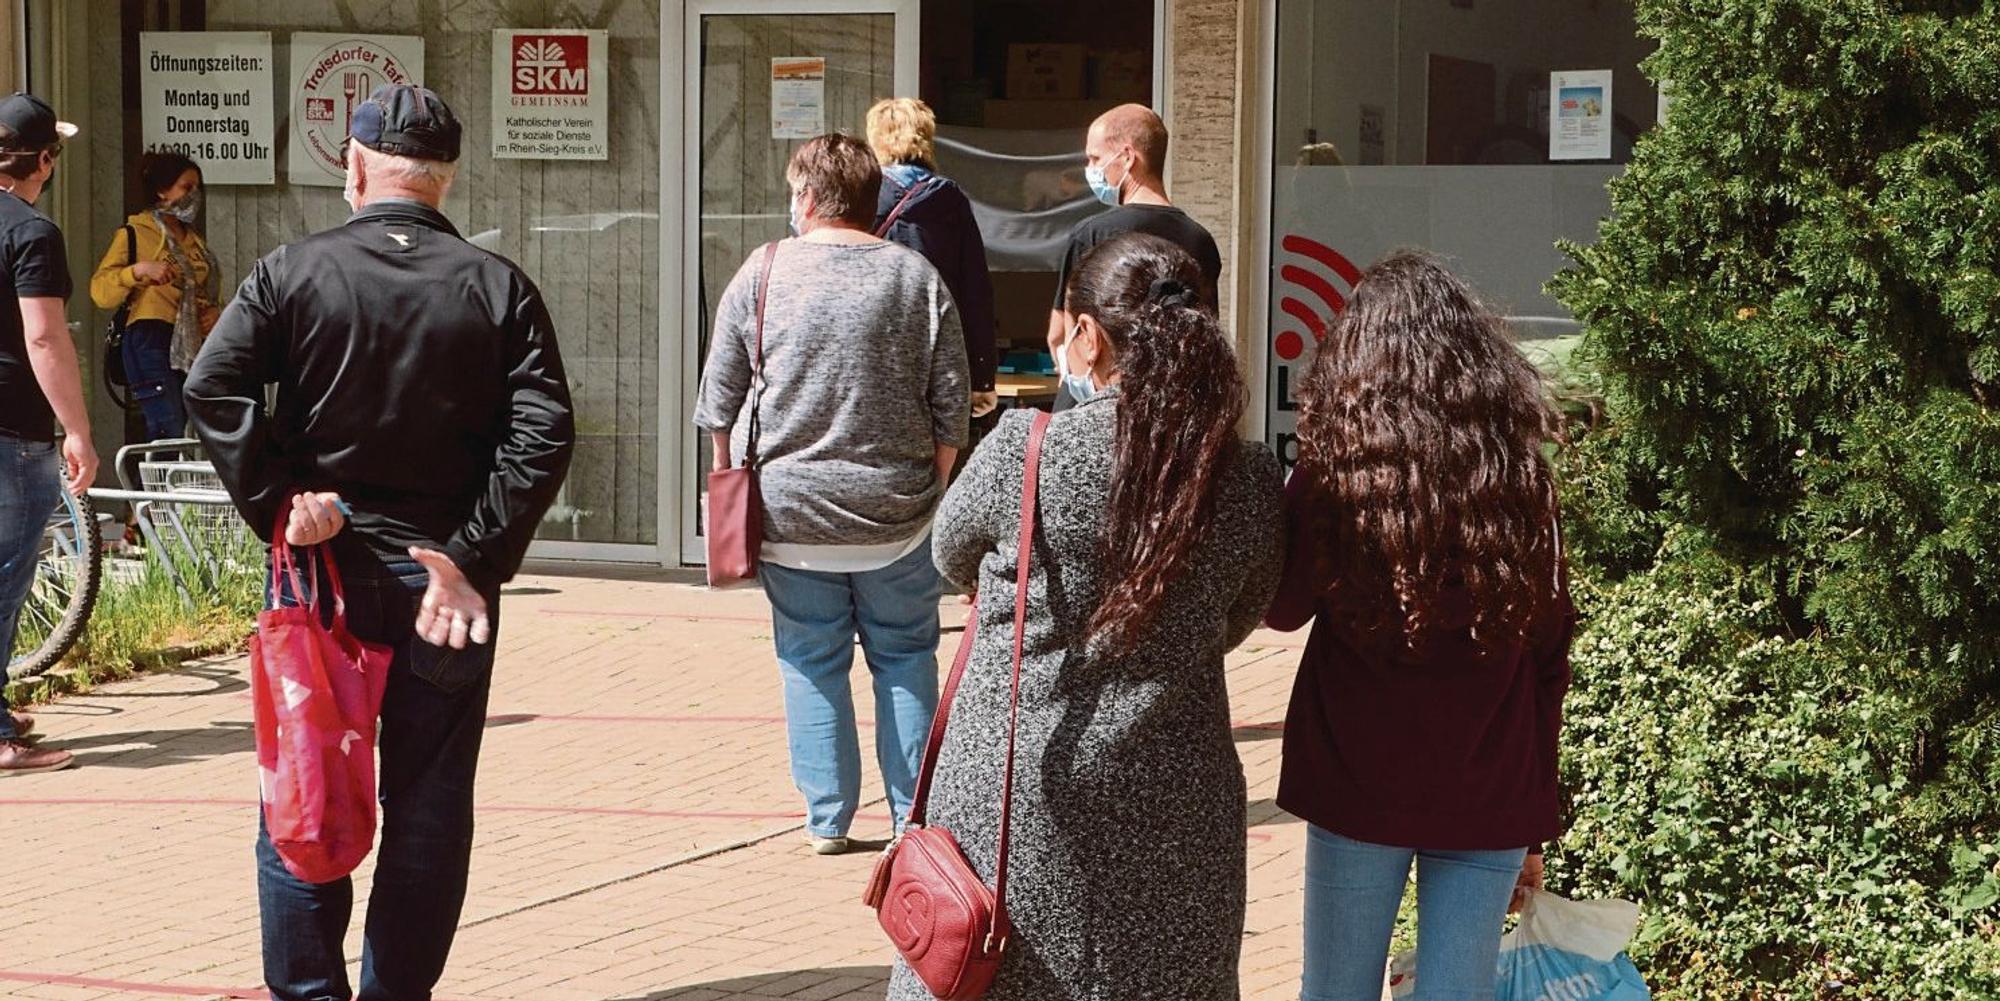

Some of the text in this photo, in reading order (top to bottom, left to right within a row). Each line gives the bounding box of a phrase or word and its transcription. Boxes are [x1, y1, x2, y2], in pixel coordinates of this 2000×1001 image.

[150, 50, 264, 75] Öffnungszeiten:
[304, 46, 379, 91] Troisdorfer
[515, 67, 586, 91] SKM
[165, 89, 250, 110] Montag und
[511, 96, 589, 107] GEMEINSAM
[308, 110, 334, 120] SKM
[506, 116, 593, 128] Katholischer Verein
[166, 115, 250, 136] Donnerstag
[508, 130, 592, 141] für soziale Dienste
[242, 142, 269, 160] Uhr
[495, 144, 508, 153] im
[509, 142, 586, 156] Rhein-Sieg-Kreis
